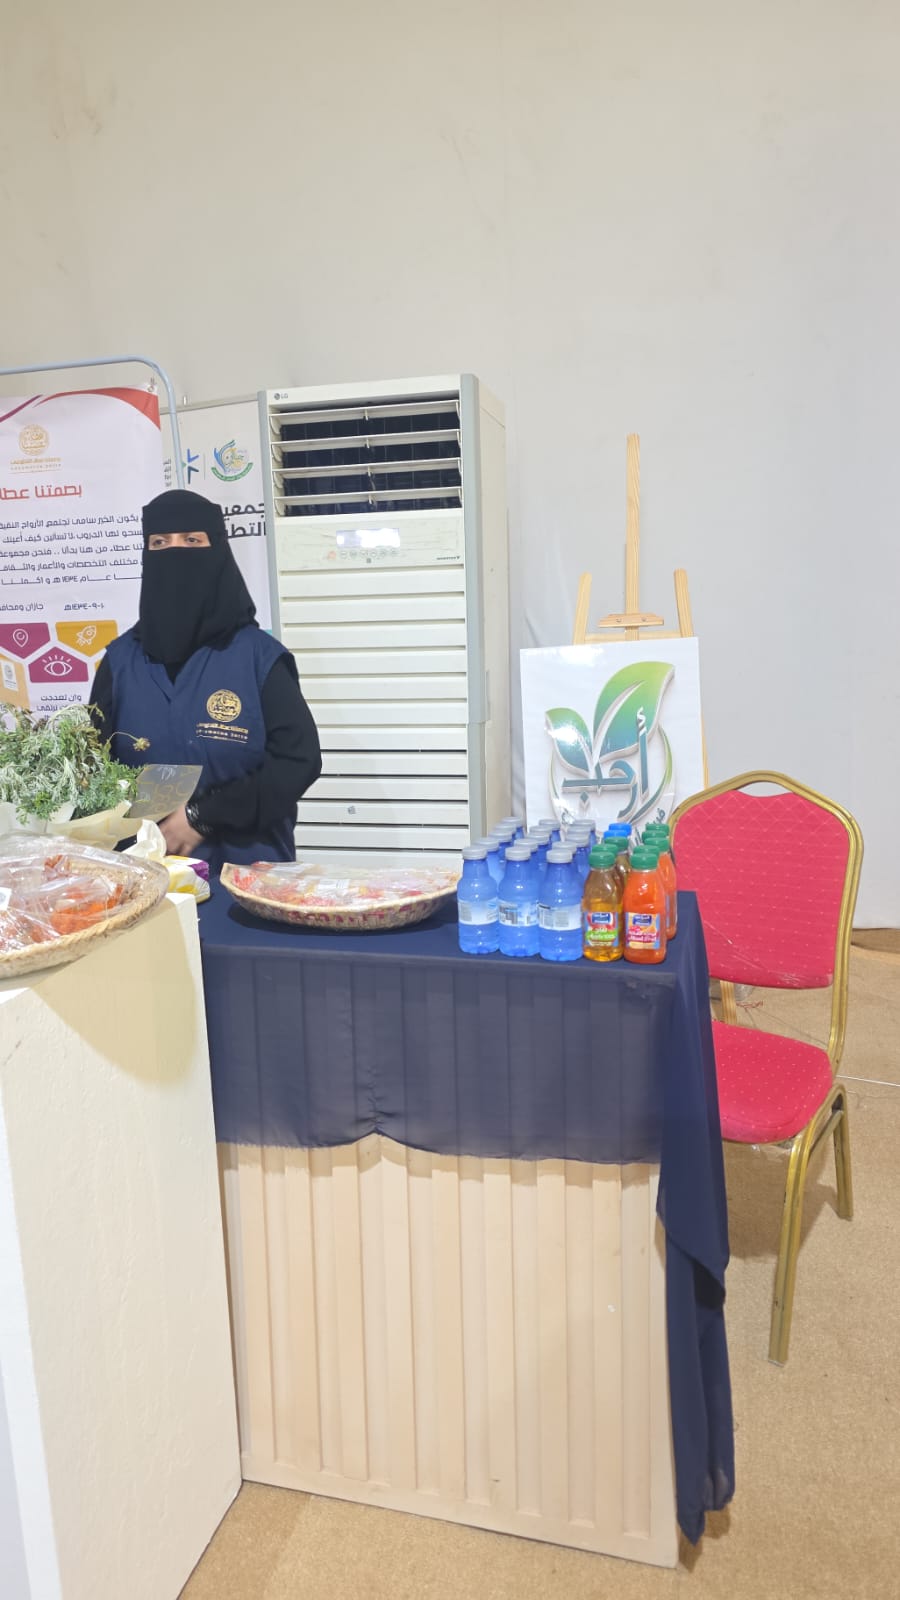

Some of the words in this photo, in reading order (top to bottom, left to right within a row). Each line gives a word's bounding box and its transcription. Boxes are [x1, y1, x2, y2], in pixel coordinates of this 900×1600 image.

[0, 487, 30, 501] عطا
[34, 484, 82, 499] بصمتنا
[223, 503, 265, 521] جمعي
[228, 521, 266, 538] التط
[0, 603, 24, 611] ومحاف
